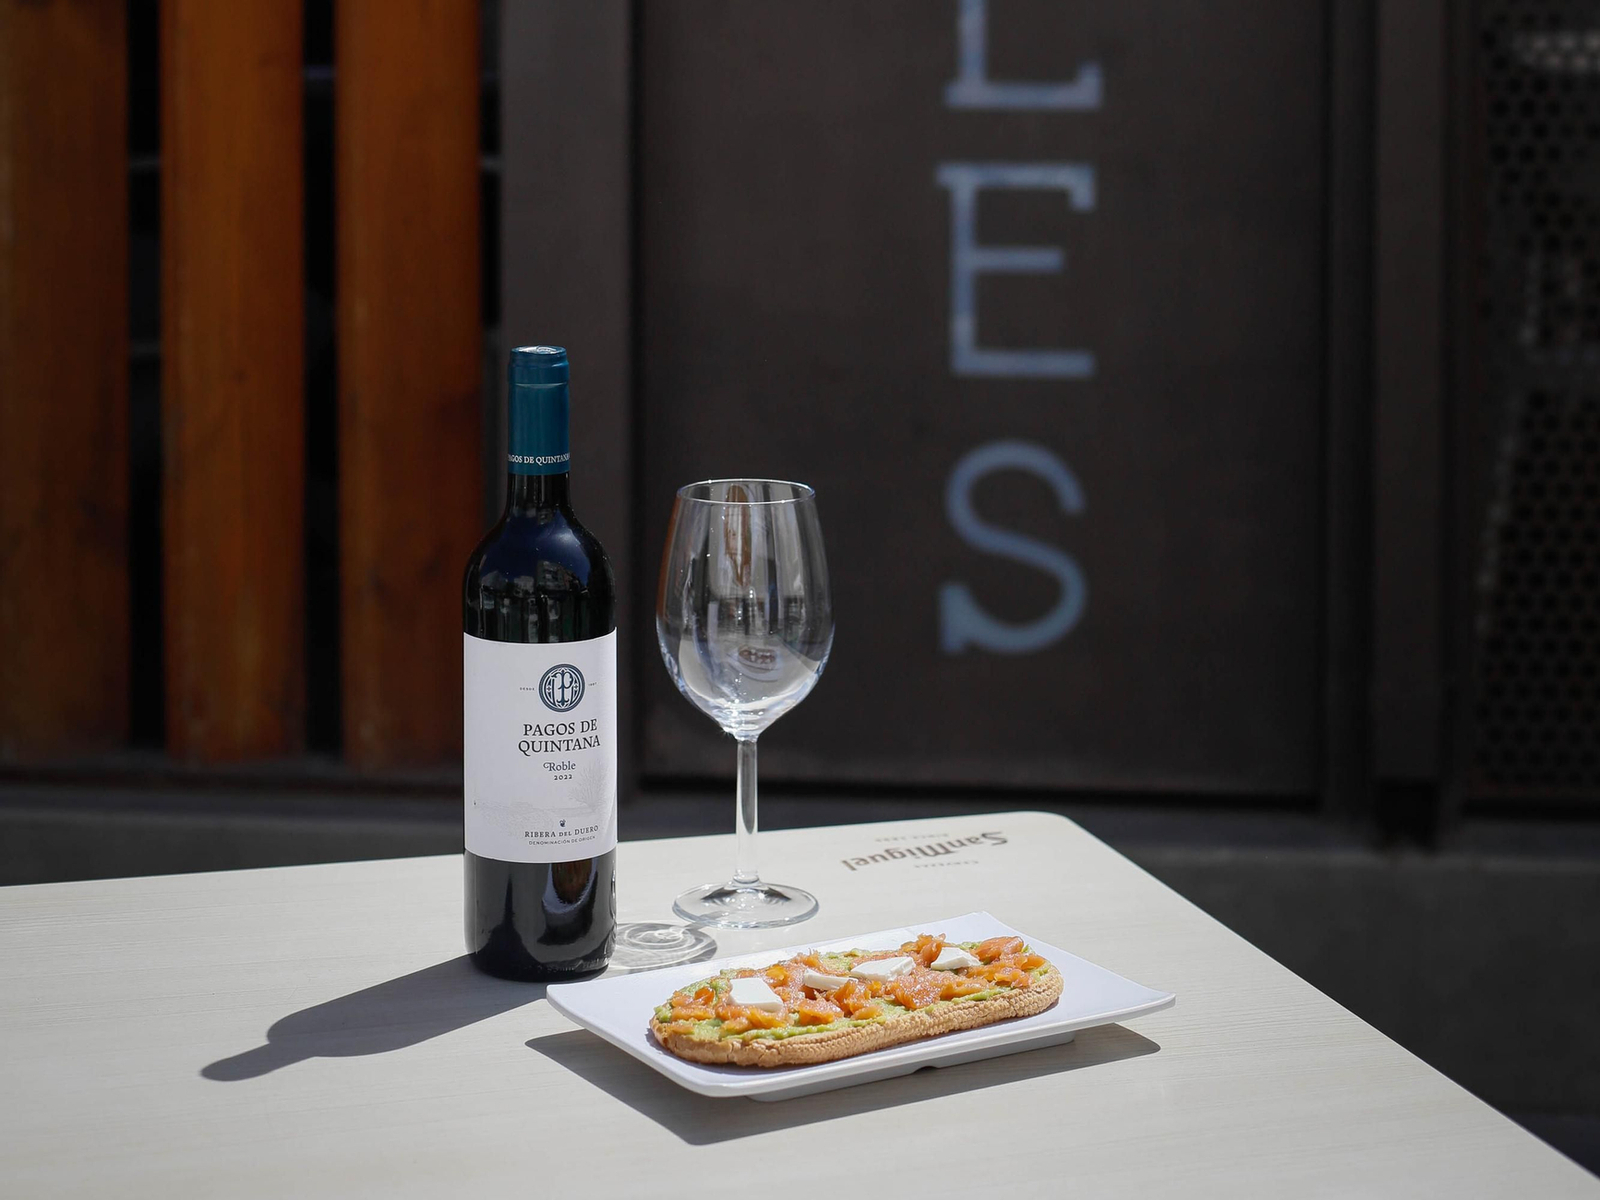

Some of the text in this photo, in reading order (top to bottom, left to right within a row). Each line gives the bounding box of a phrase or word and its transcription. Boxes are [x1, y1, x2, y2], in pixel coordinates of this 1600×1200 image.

[523, 456, 535, 464] DE
[523, 718, 598, 736] PAGOS DE
[518, 735, 601, 756] QUINTANA
[543, 761, 576, 772] Roble
[574, 825, 599, 835] DUERO
